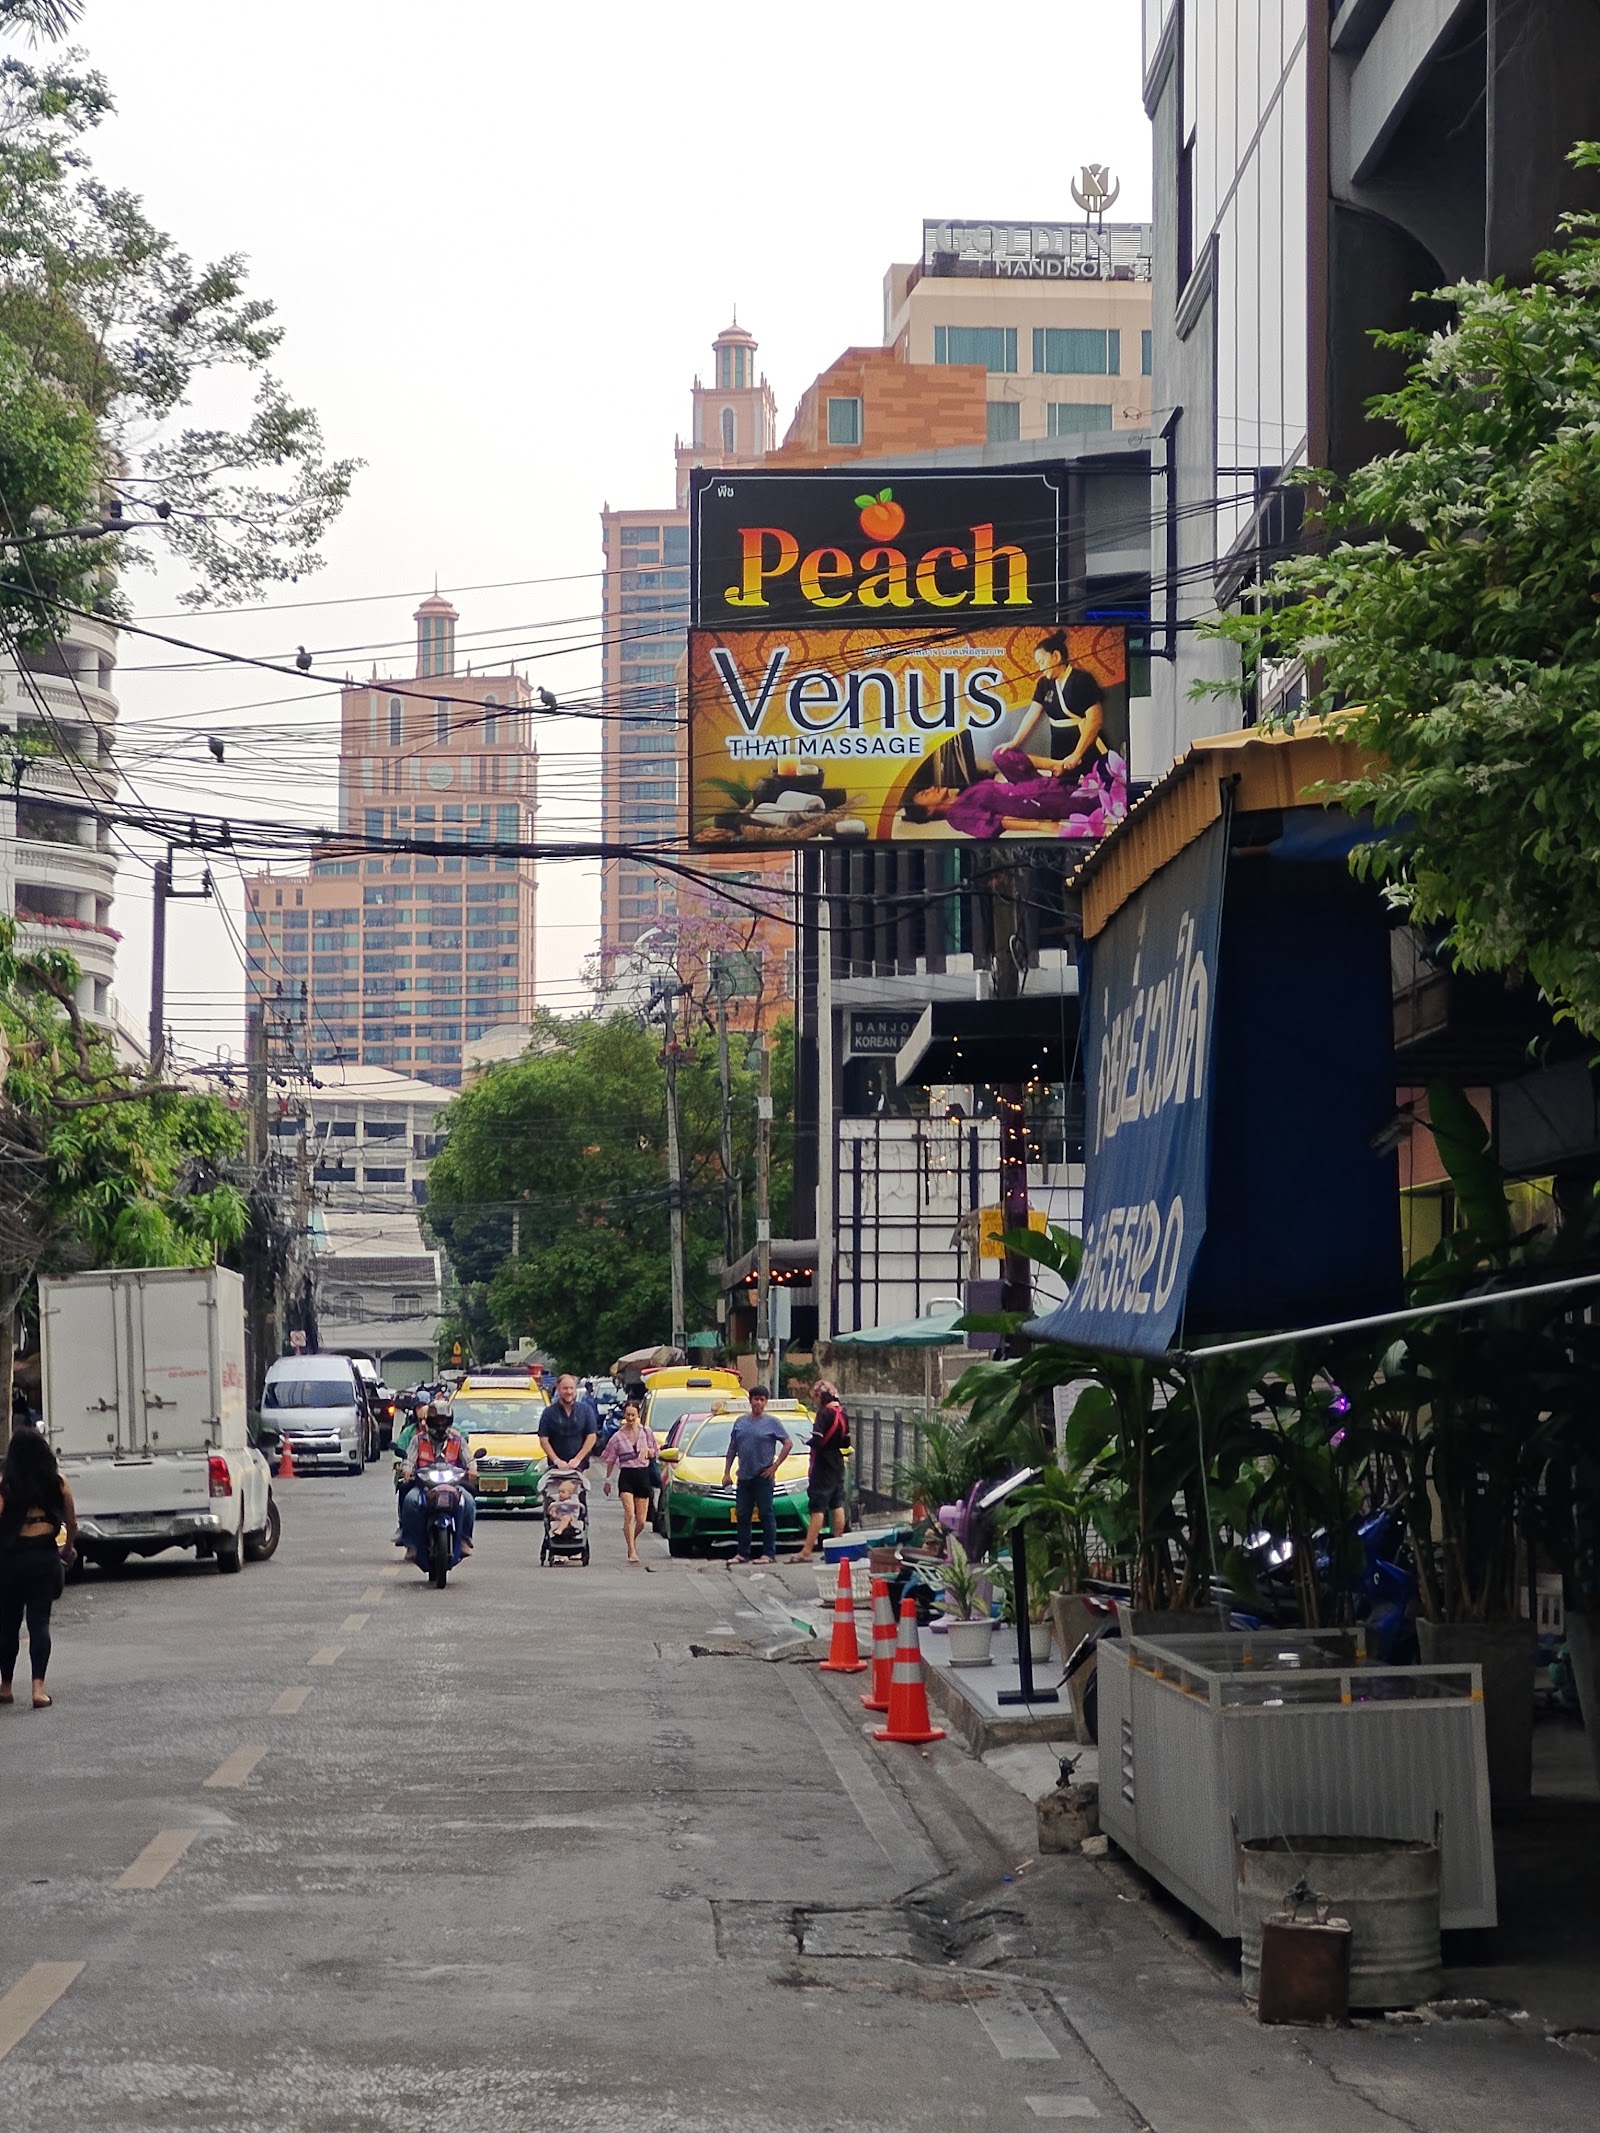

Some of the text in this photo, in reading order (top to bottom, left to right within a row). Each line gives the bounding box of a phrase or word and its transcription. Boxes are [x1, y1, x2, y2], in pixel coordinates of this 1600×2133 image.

[717, 484, 734, 498] พีช
[723, 522, 1034, 609] Peach
[711, 647, 1005, 735] Venus
[729, 737, 922, 757] THAI MASSAGE
[855, 1035, 897, 1048] KOREAN
